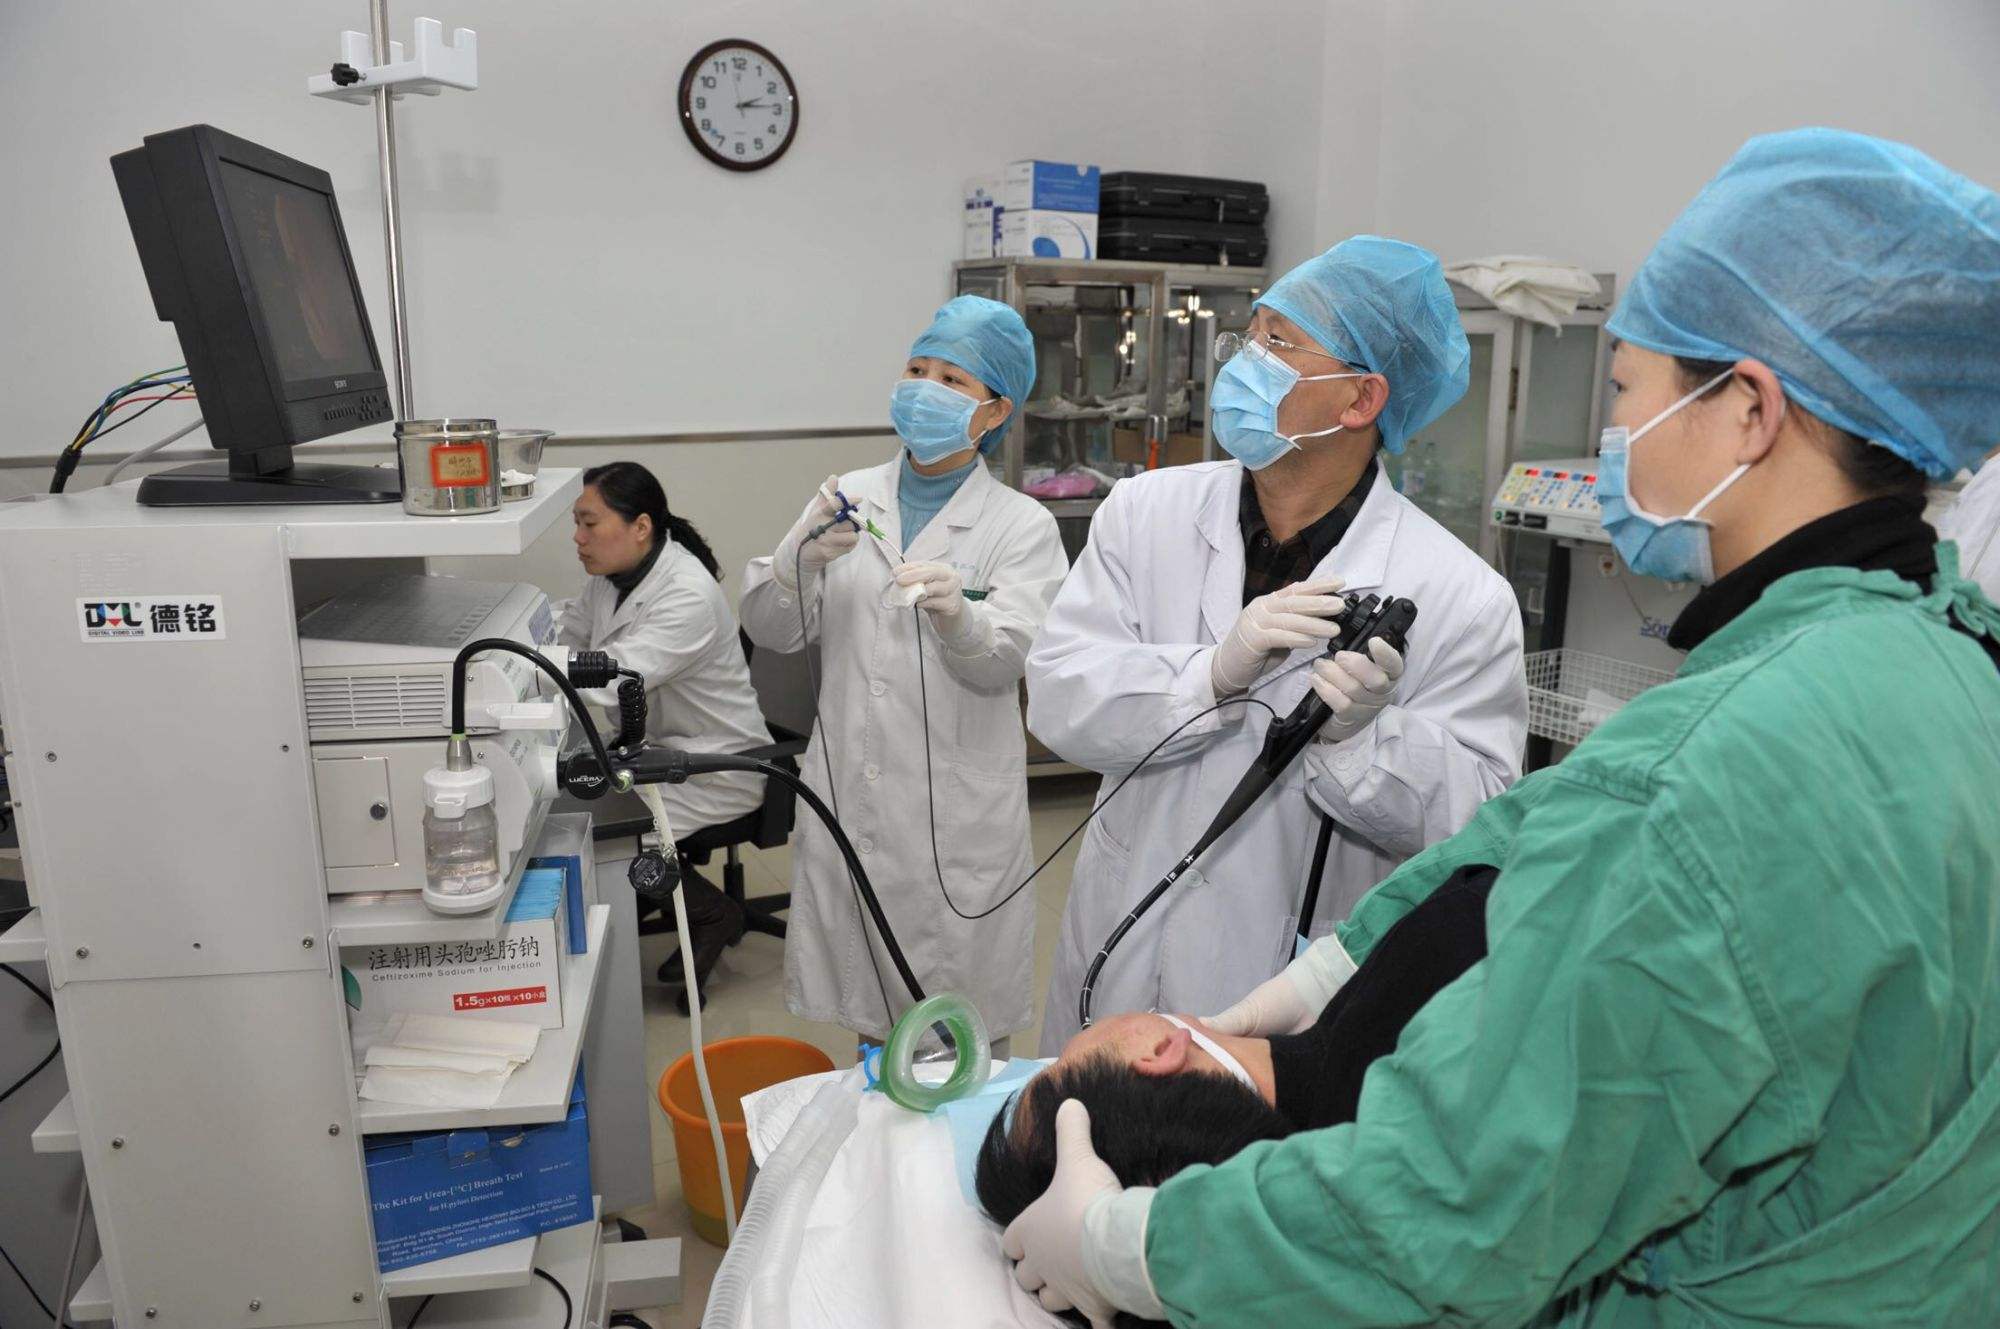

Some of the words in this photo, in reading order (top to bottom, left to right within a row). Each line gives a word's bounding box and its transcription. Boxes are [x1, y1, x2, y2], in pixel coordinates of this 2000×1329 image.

[713, 61, 727, 74] 11
[731, 57, 748, 70] 12
[755, 65, 763, 77] 1
[701, 75, 717, 89] 10
[766, 81, 777, 94] 2
[695, 97, 706, 109] 9
[772, 103, 782, 116] 3
[701, 118, 711, 131] 8
[767, 124, 777, 135] 4
[716, 134, 726, 147] 7
[753, 138, 764, 150] 5
[734, 142, 745, 155] 6
[150, 603, 217, 633] 德铭
[368, 936, 539, 971] 注射用头孢唑肟钠
[438, 966, 476, 977] Sodium
[479, 965, 493, 974] for
[497, 960, 542, 972] Injection
[374, 1201, 391, 1211] The
[392, 1197, 408, 1208] Kit
[409, 1194, 423, 1205] for
[474, 1176, 503, 1189] Breath
